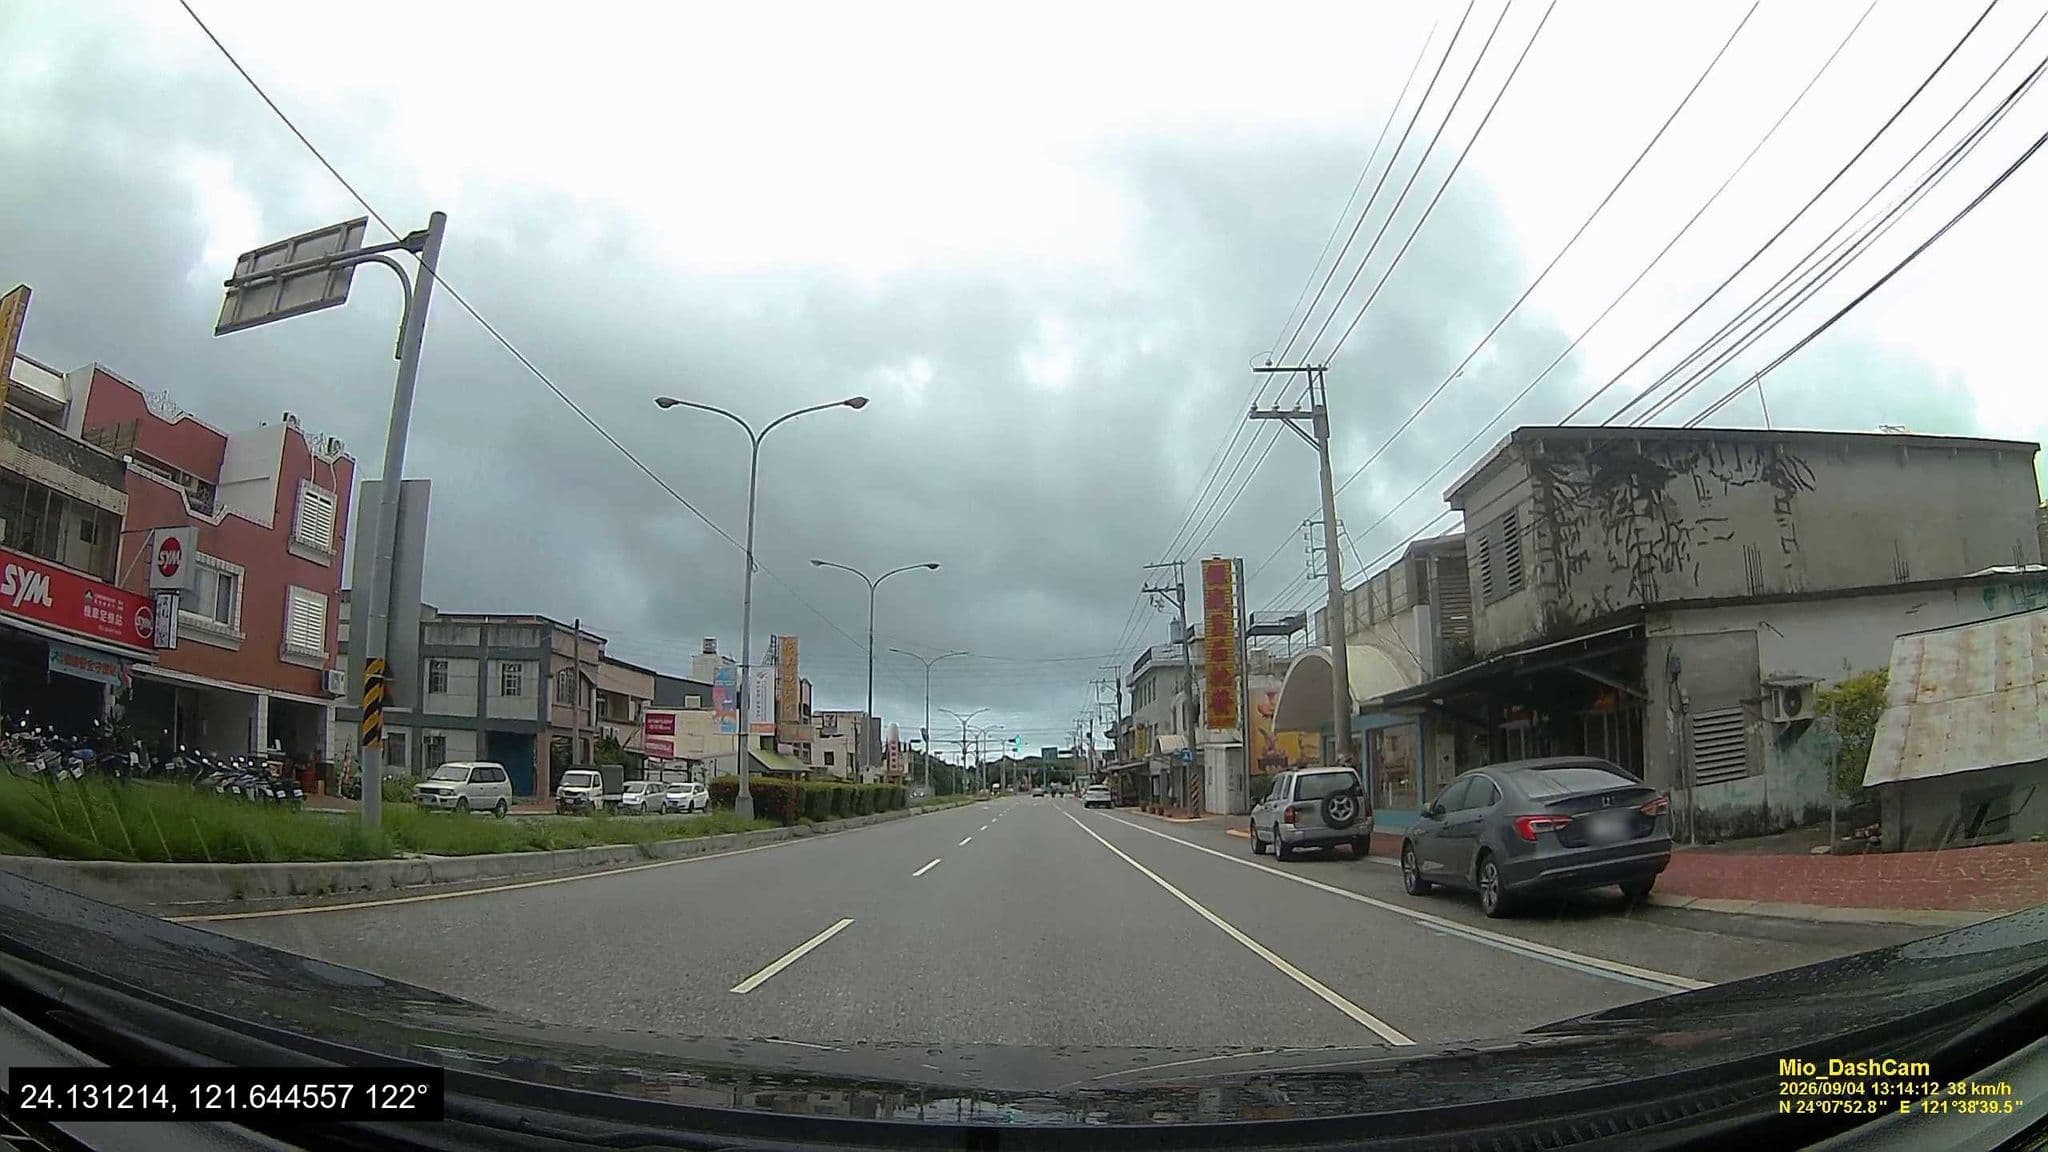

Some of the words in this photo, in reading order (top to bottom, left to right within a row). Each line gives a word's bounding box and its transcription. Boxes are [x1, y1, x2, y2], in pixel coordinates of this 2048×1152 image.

[158, 549, 182, 572] SYM
[1, 563, 53, 608] SYM
[136, 615, 153, 630] SYM
